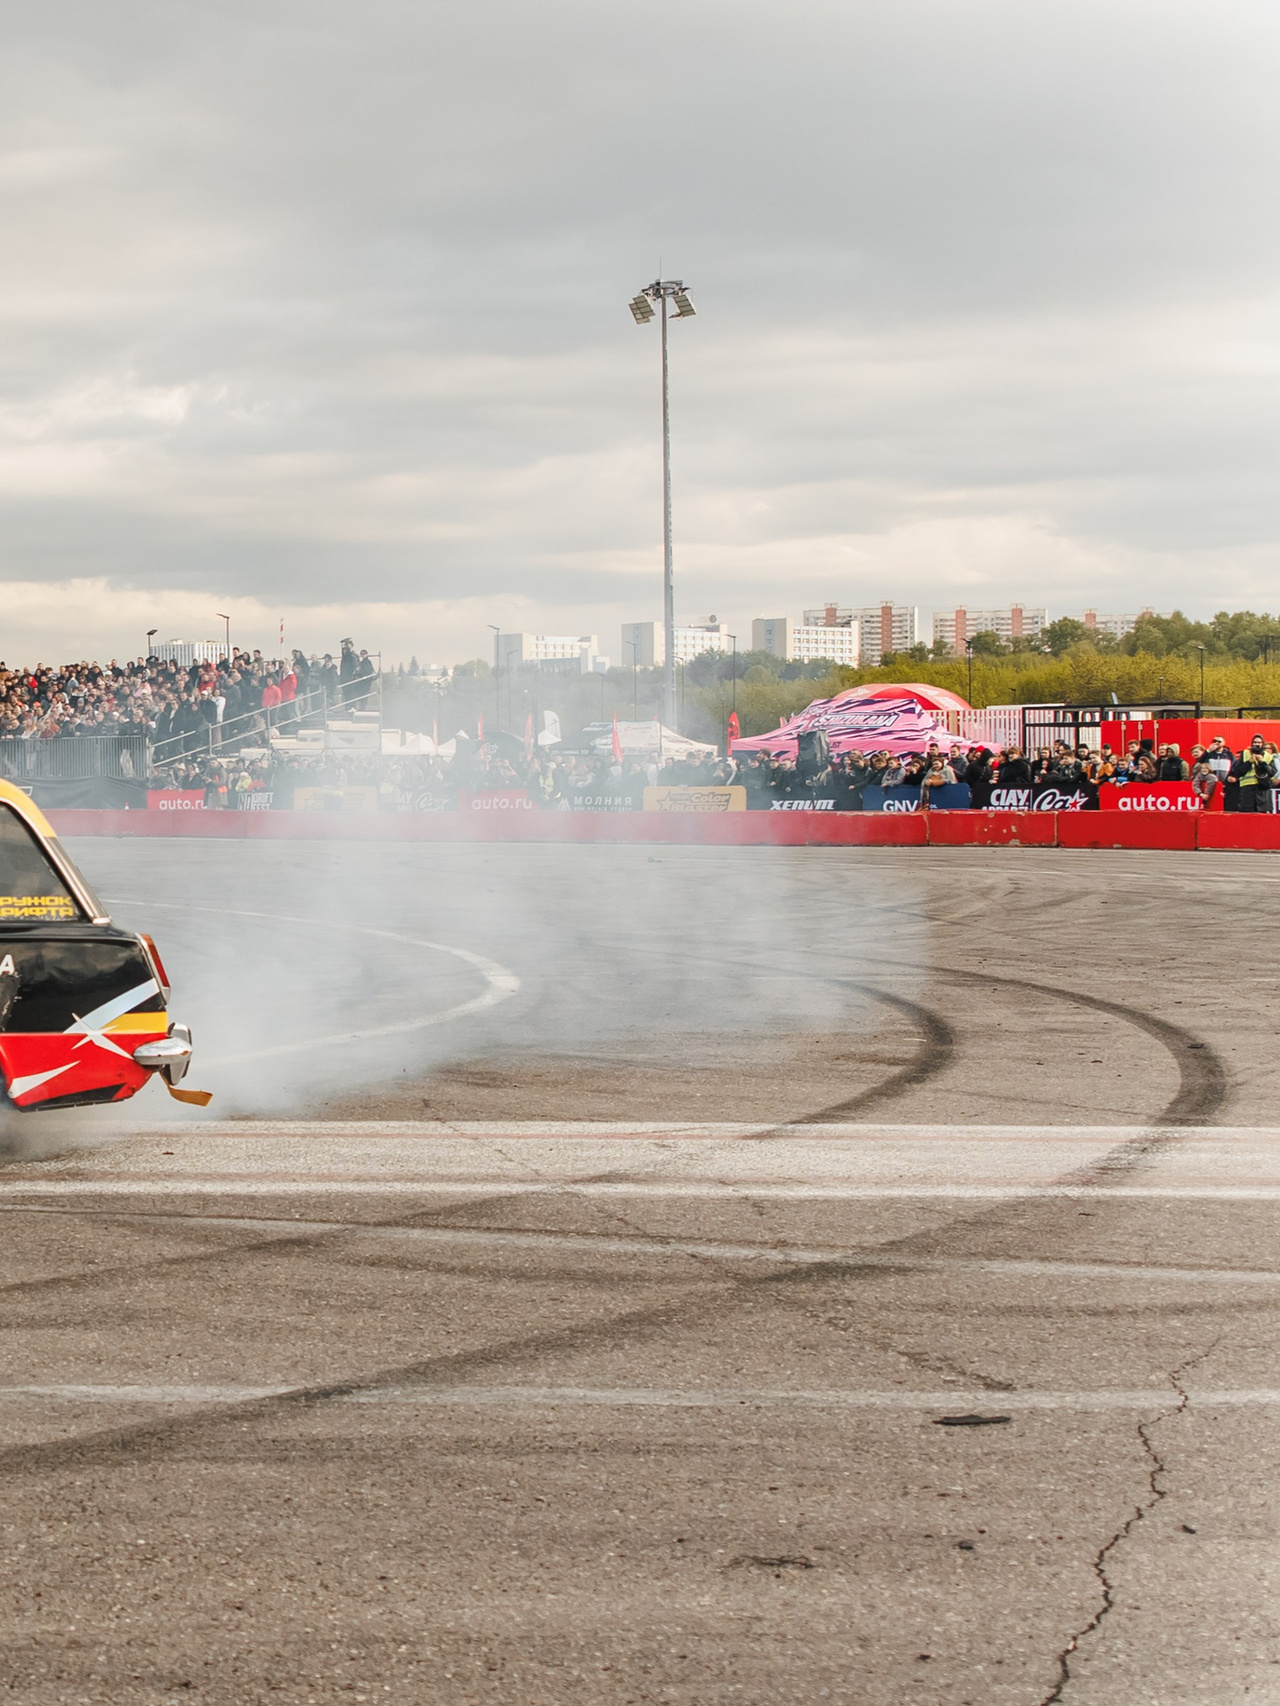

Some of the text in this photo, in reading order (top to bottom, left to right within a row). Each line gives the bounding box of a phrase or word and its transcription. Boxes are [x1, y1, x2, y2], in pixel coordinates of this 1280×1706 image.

[472, 796, 533, 810] auto.ru
[573, 796, 632, 806] МОЛНИЯ
[882, 800, 919, 812] GNV
[1118, 794, 1200, 811] auto.ru
